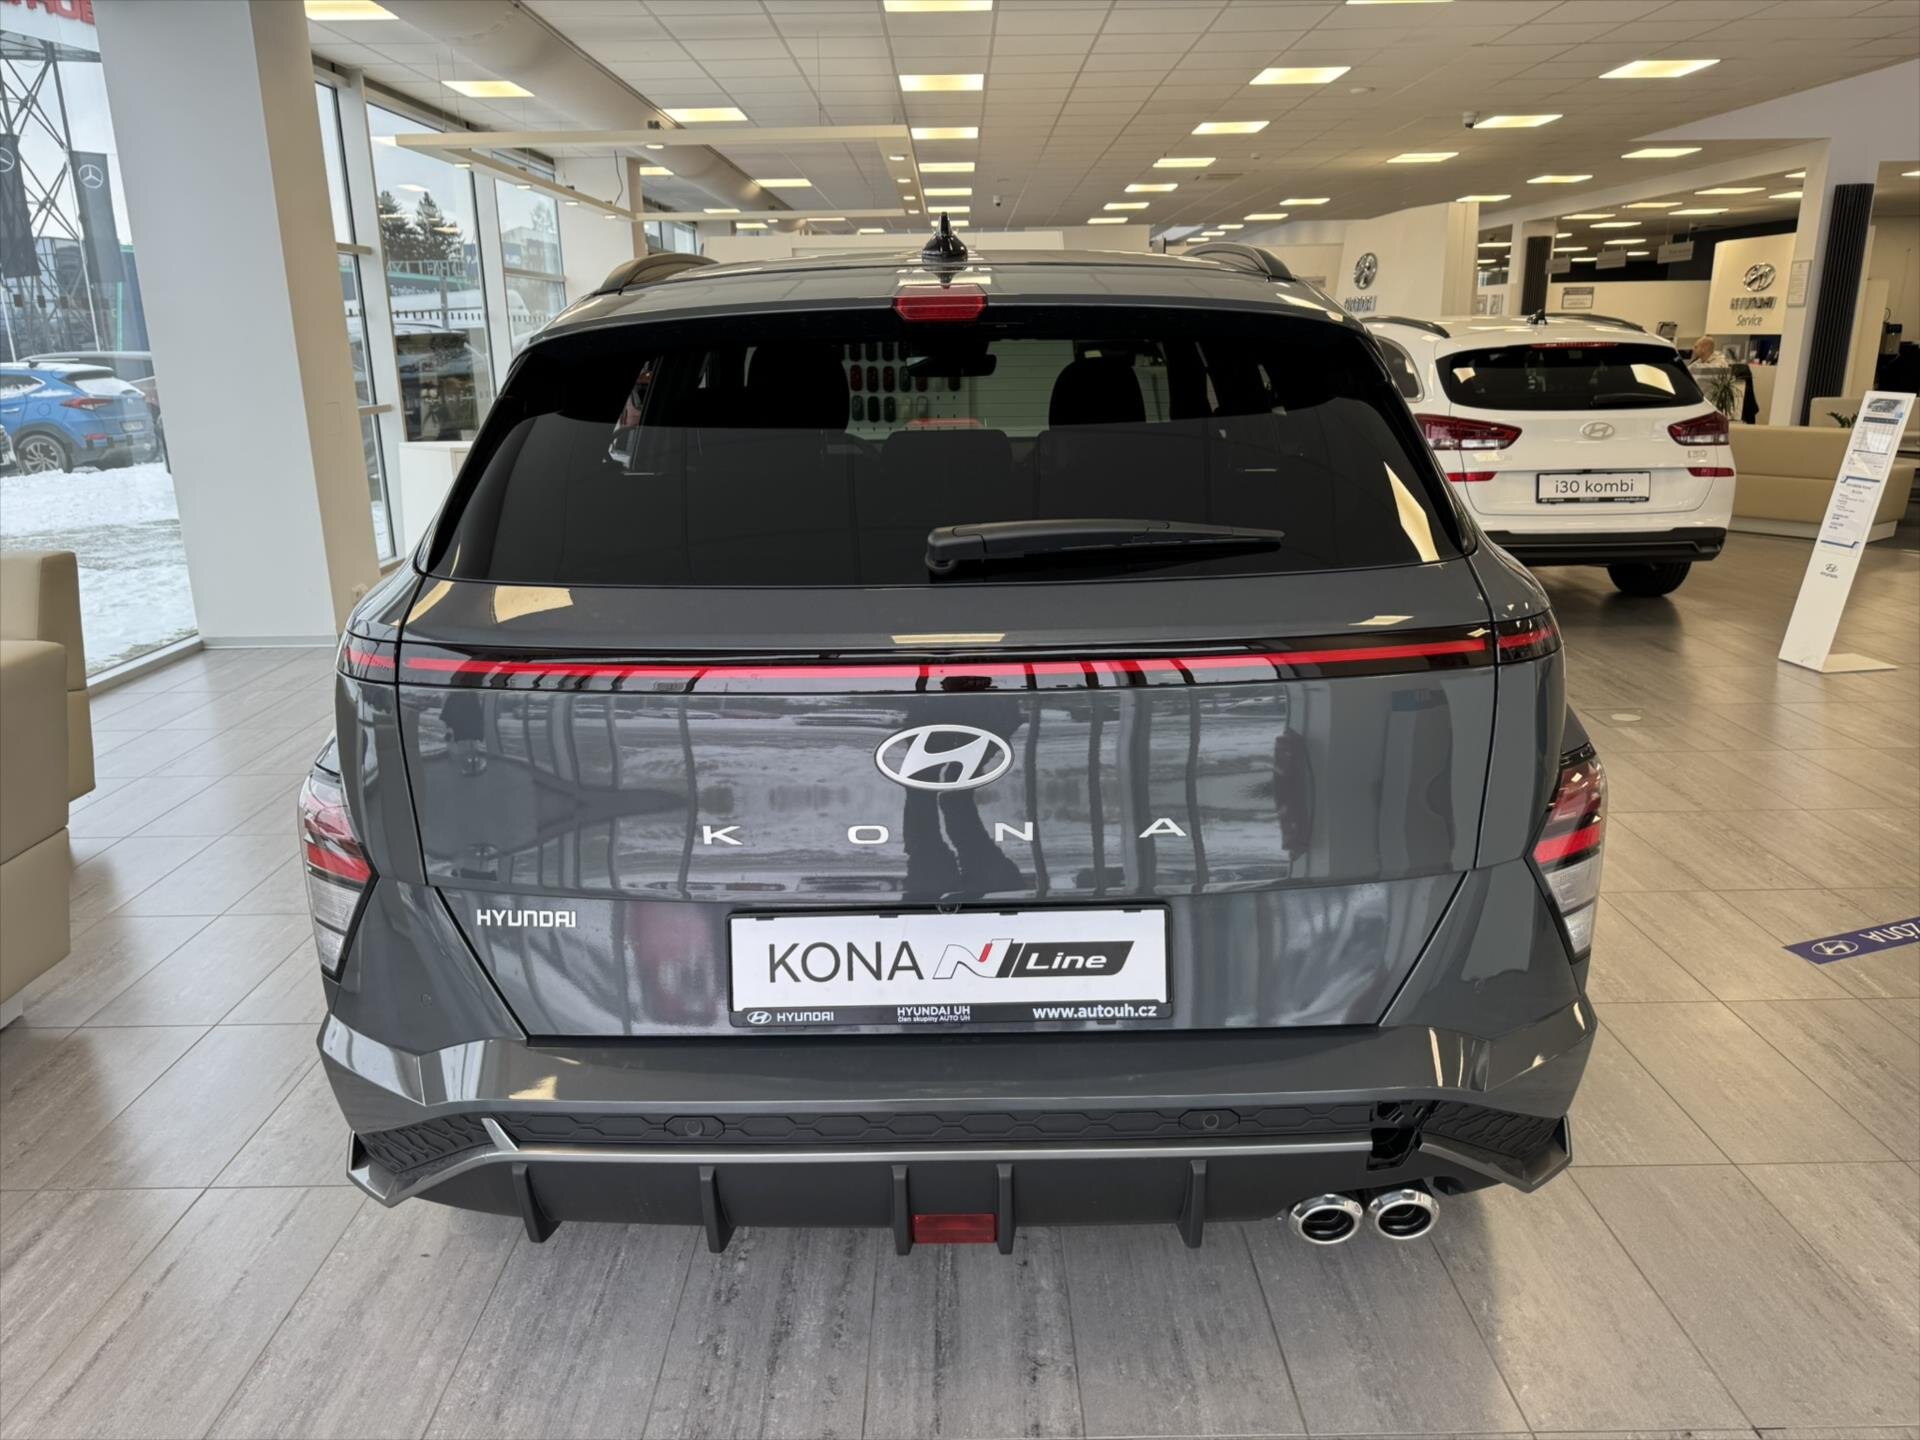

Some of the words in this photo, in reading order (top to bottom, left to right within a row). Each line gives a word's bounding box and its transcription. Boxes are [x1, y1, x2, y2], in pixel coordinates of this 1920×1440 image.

[1736, 314, 1763, 327] Service
[1555, 480, 1580, 494] i30
[1585, 478, 1635, 493] kombi
[476, 909, 576, 928] HYUNDAI
[769, 940, 925, 983] KONA
[1026, 952, 1108, 971] Line
[776, 1011, 834, 1022] HYUNDAI
[897, 1006, 951, 1016] HYUNDAI
[954, 1005, 971, 1015] UH
[1033, 1003, 1157, 1019] www.autouh.cz
[939, 1014, 959, 1022] AUTO
